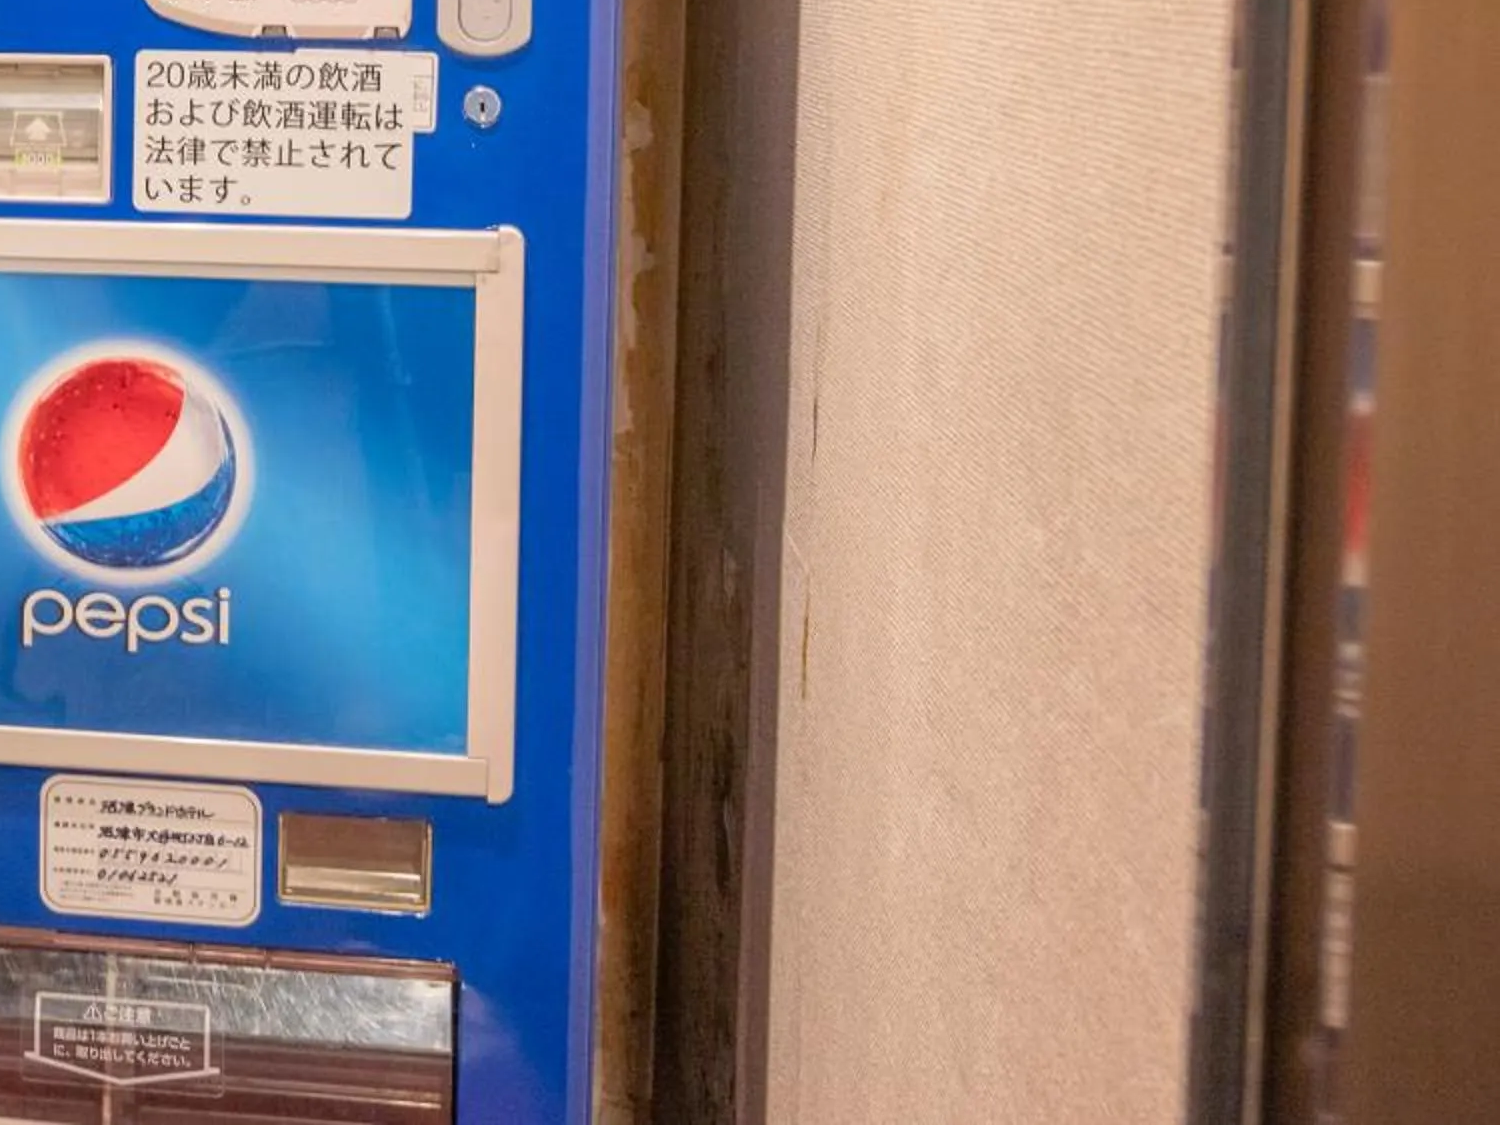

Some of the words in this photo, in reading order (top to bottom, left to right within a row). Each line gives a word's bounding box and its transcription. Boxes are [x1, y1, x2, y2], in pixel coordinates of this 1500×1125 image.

[147, 60, 383, 92] 20歳未満の飲酒
[145, 98, 403, 132] および飲酒運転は
[144, 135, 403, 171] 法律で禁止されて
[145, 175, 252, 206] います。
[22, 587, 232, 653] pepsi
